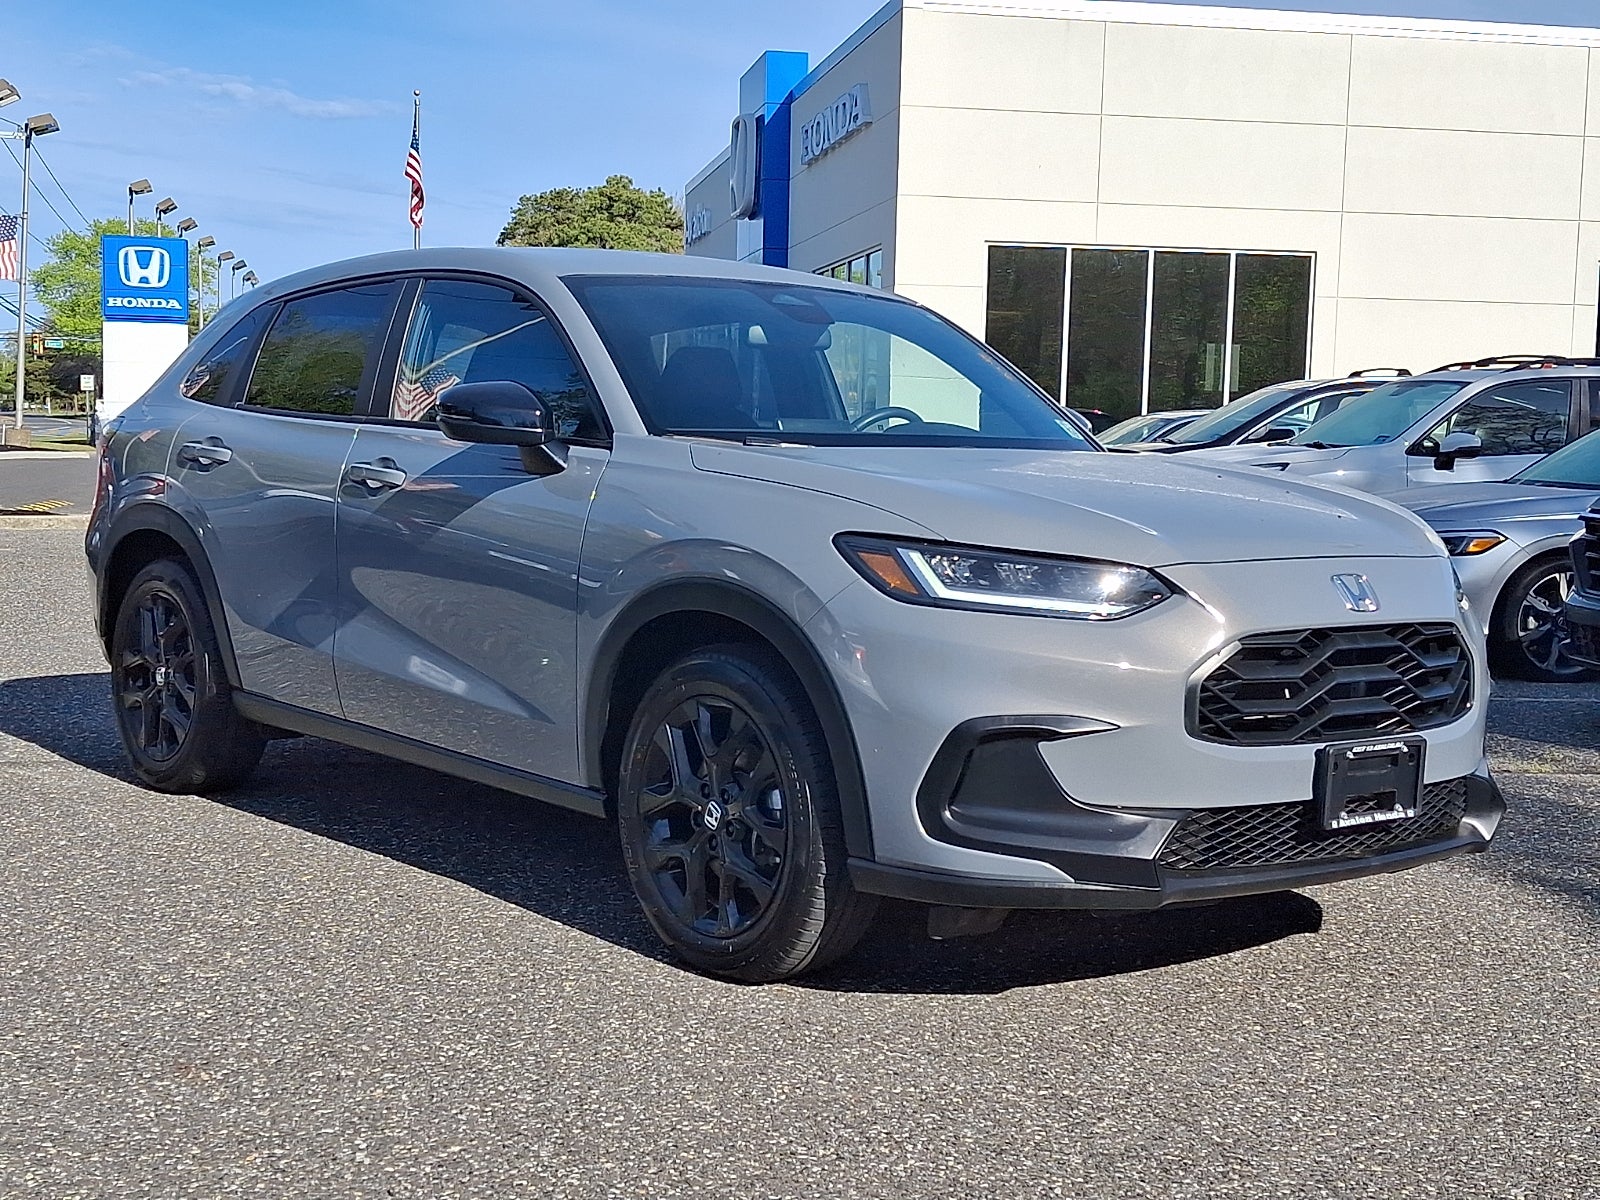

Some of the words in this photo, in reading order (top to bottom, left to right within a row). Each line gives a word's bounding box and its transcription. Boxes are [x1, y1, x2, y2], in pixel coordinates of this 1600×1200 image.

[801, 84, 871, 165] HONDA
[107, 297, 183, 310] HONDA
[1338, 814, 1373, 828] Avalon
[1373, 810, 1406, 822] Honda
